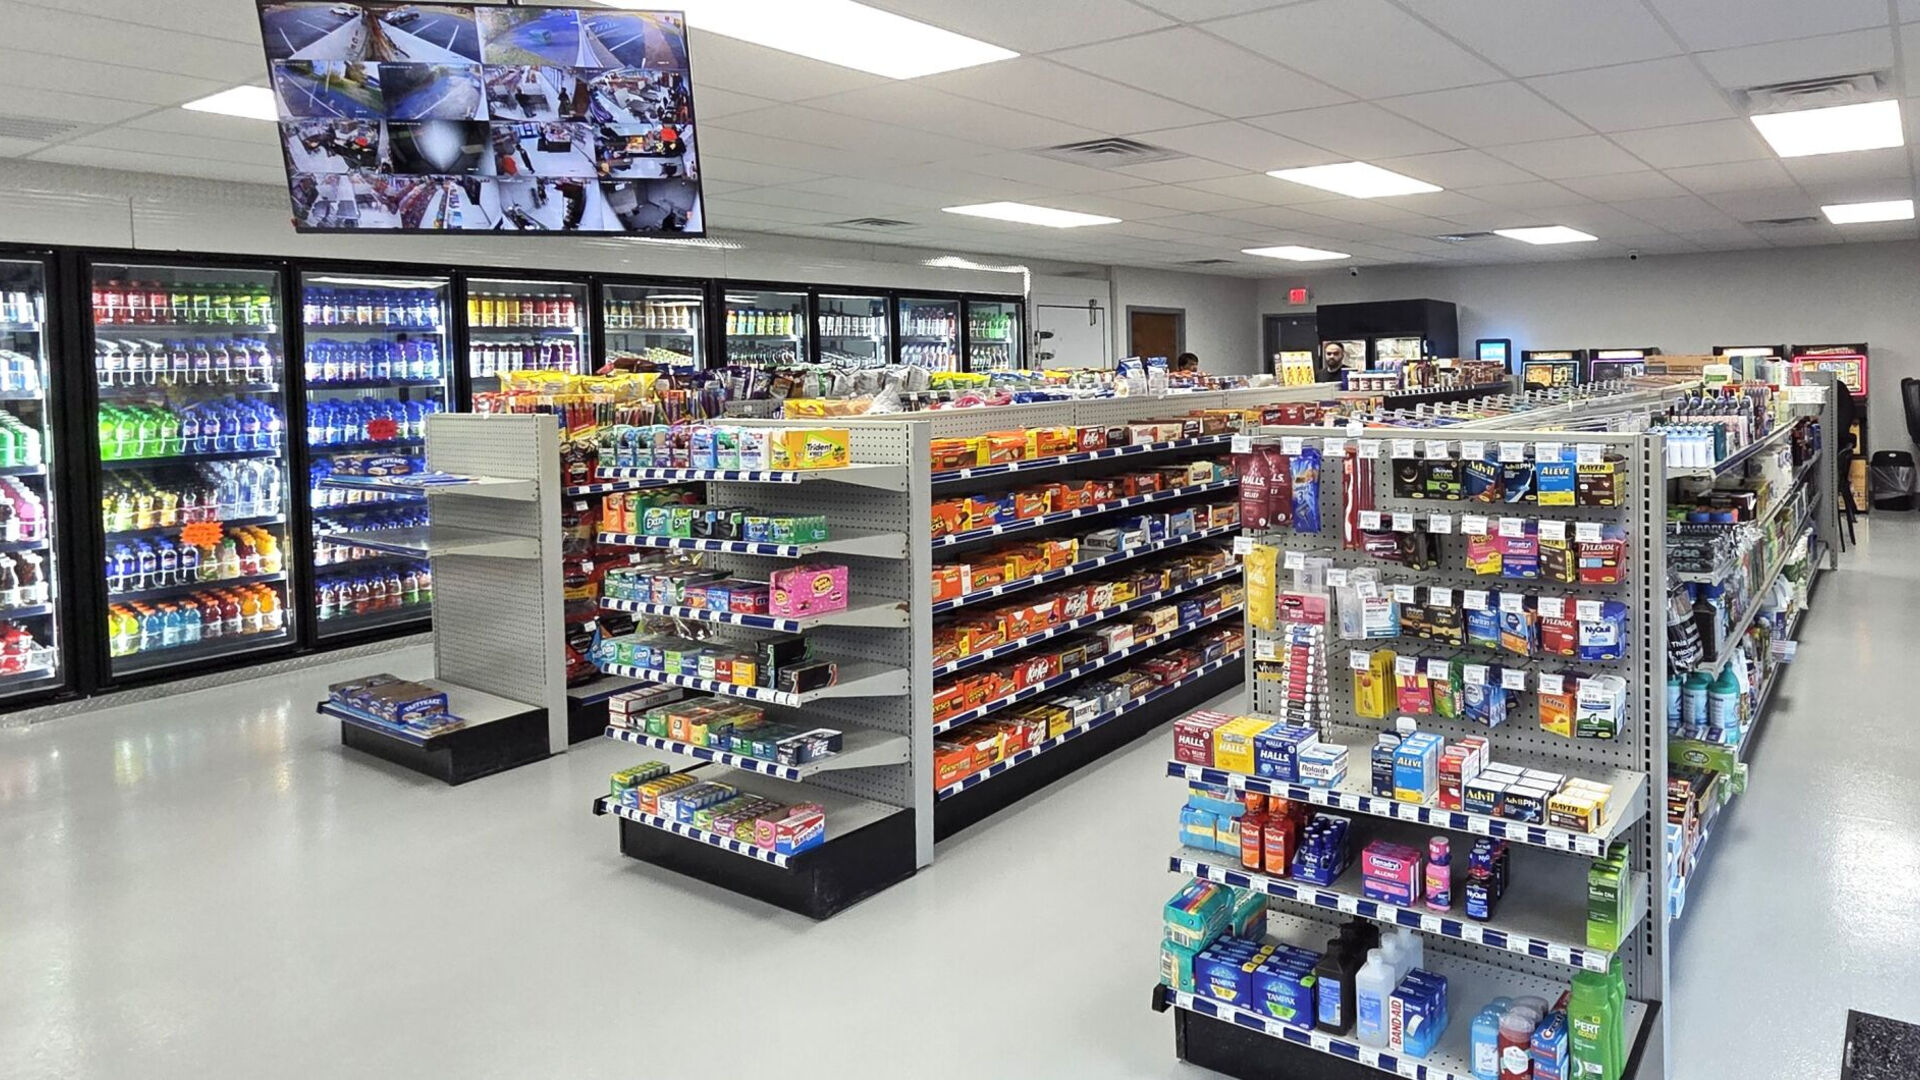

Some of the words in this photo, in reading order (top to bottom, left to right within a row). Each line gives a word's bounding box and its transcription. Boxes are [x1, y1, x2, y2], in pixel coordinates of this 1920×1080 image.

[807, 443, 832, 451] Trident
[1468, 460, 1495, 476] Advil
[1541, 467, 1570, 475] ALEVE
[1242, 475, 1265, 486] HALLS
[1582, 543, 1614, 552] TYLENOL
[1468, 615, 1491, 626] Claritin
[1542, 617, 1573, 628] TYLENOL
[1585, 626, 1611, 635] NyQuil
[404, 698, 441, 712] TASTYKAKE
[1178, 735, 1204, 747] HALLS
[812, 745, 828, 757] ICE
[1219, 742, 1247, 754] HALLS
[1260, 750, 1290, 762] HALLS
[1396, 756, 1422, 768] ALEVE
[1301, 763, 1329, 776] Rolaids
[1466, 787, 1495, 803] Advil
[1551, 801, 1579, 814] BAYER
[1372, 857, 1400, 871] Benadryl
[1374, 869, 1399, 879] ALLERGY
[1466, 889, 1488, 901] NyQuil
[1210, 977, 1237, 989] TAMPAX
[1266, 992, 1296, 1005] TAMPAX
[1391, 1000, 1402, 1045] BAND-AID
[1574, 1019, 1601, 1034] PERT
